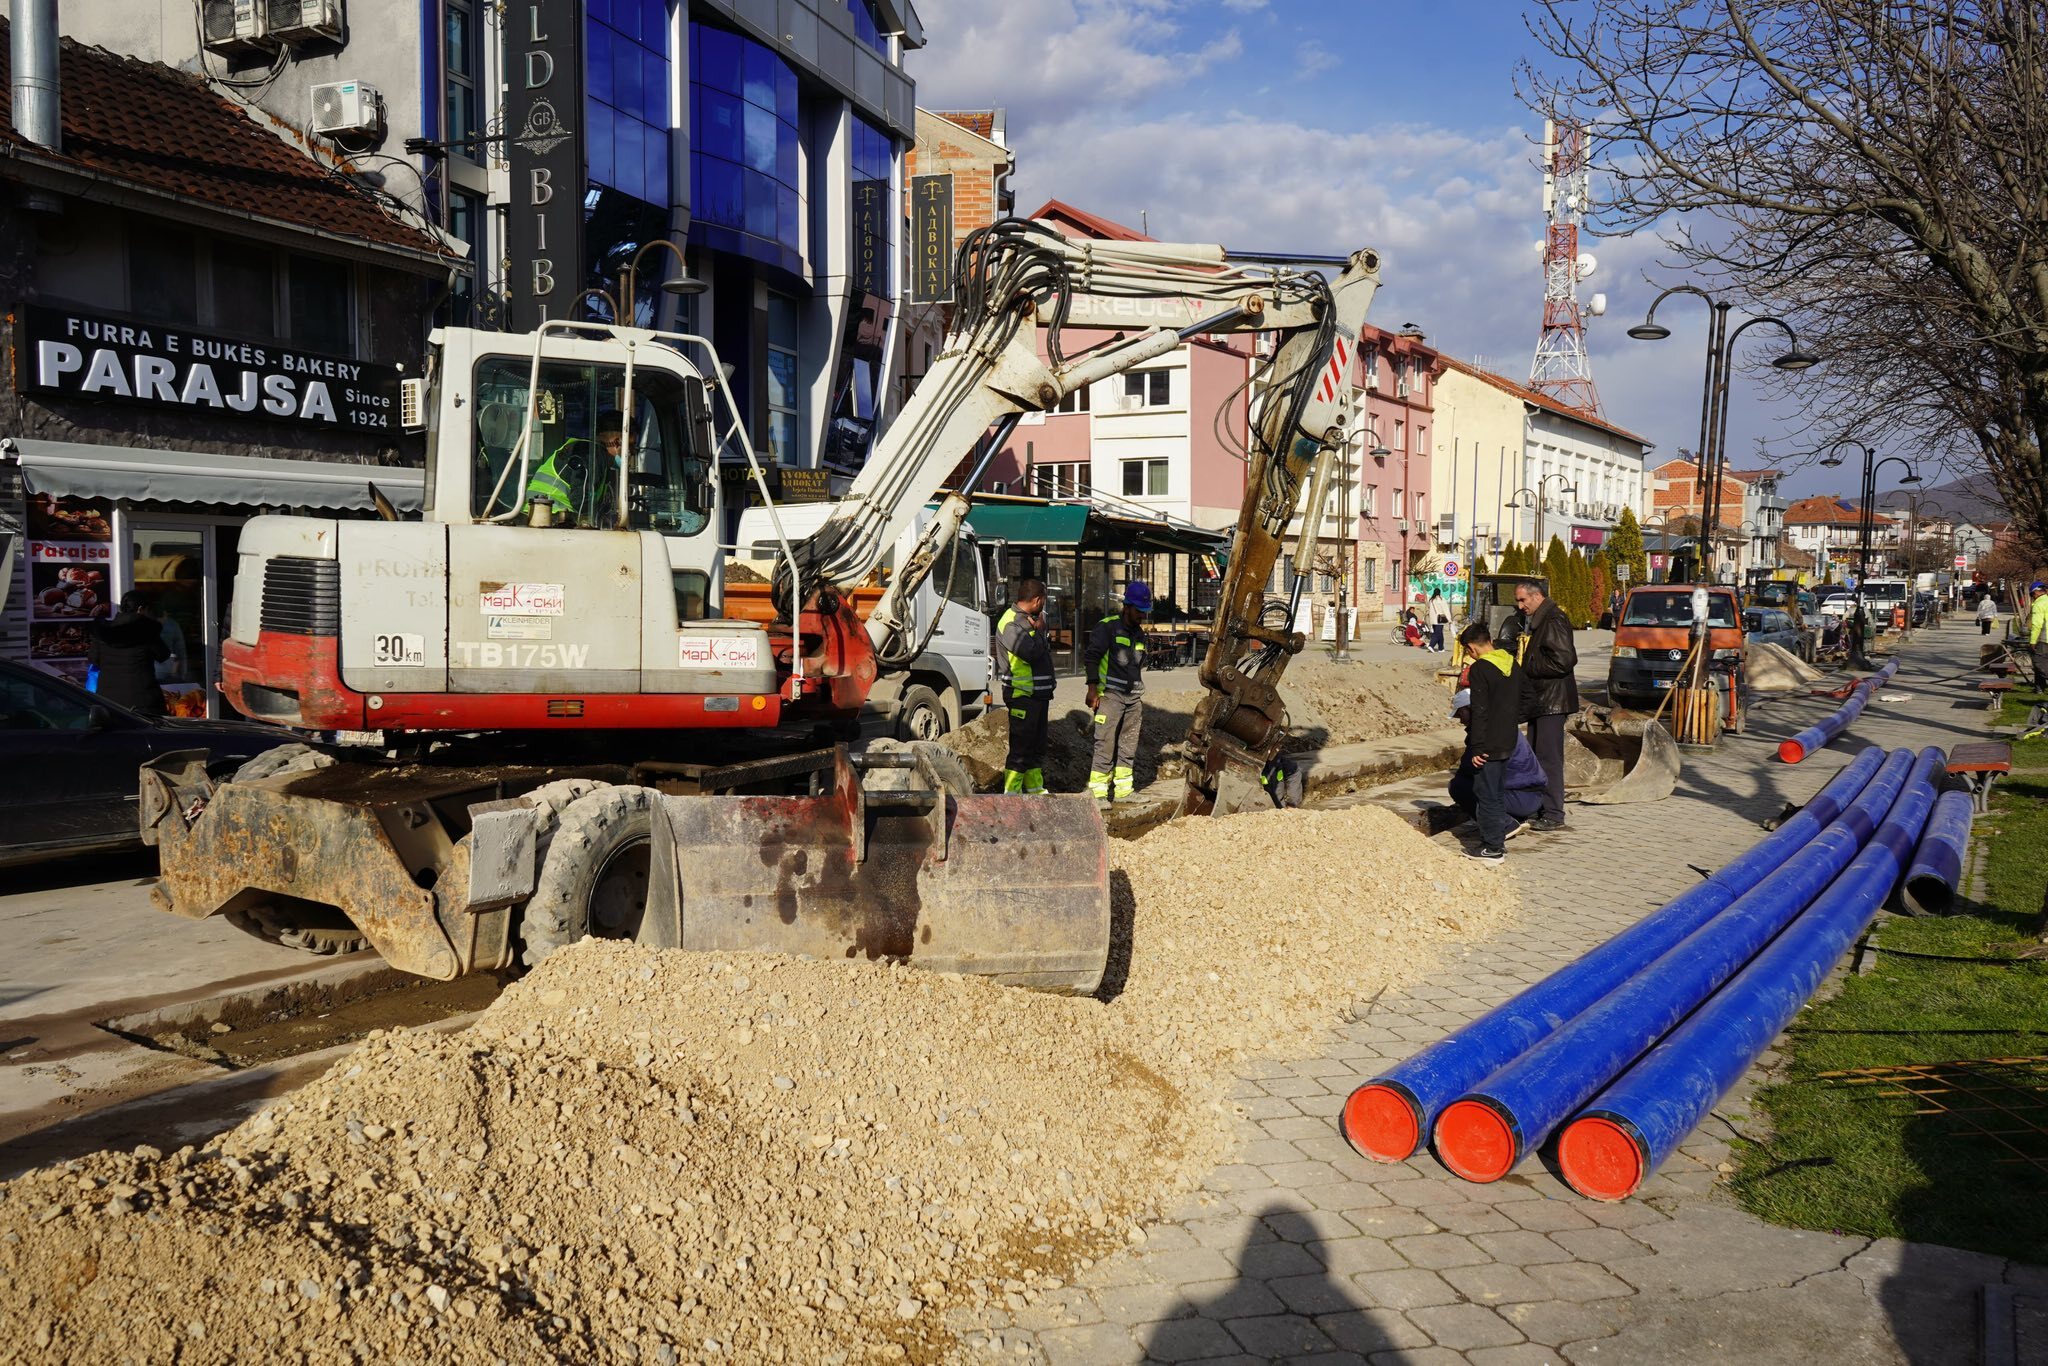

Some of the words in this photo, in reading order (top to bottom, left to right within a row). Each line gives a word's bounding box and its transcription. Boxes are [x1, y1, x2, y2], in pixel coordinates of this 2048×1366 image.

[532, 112, 551, 127] GB
[928, 205, 938, 295] АДВОКАТ
[66, 318, 153, 348] FURRA
[166, 334, 179, 352] E
[192, 338, 266, 366] BUKËS
[283, 354, 361, 381] BAKERY
[38, 340, 338, 422] PARAJSA
[346, 388, 391, 408] Since
[350, 410, 388, 428] 1924
[32, 543, 110, 560] Parajsa
[503, 617, 550, 625] KLEINHEIDER
[377, 635, 404, 662] 30
[406, 648, 422, 662] km
[456, 642, 590, 668] TB175W
